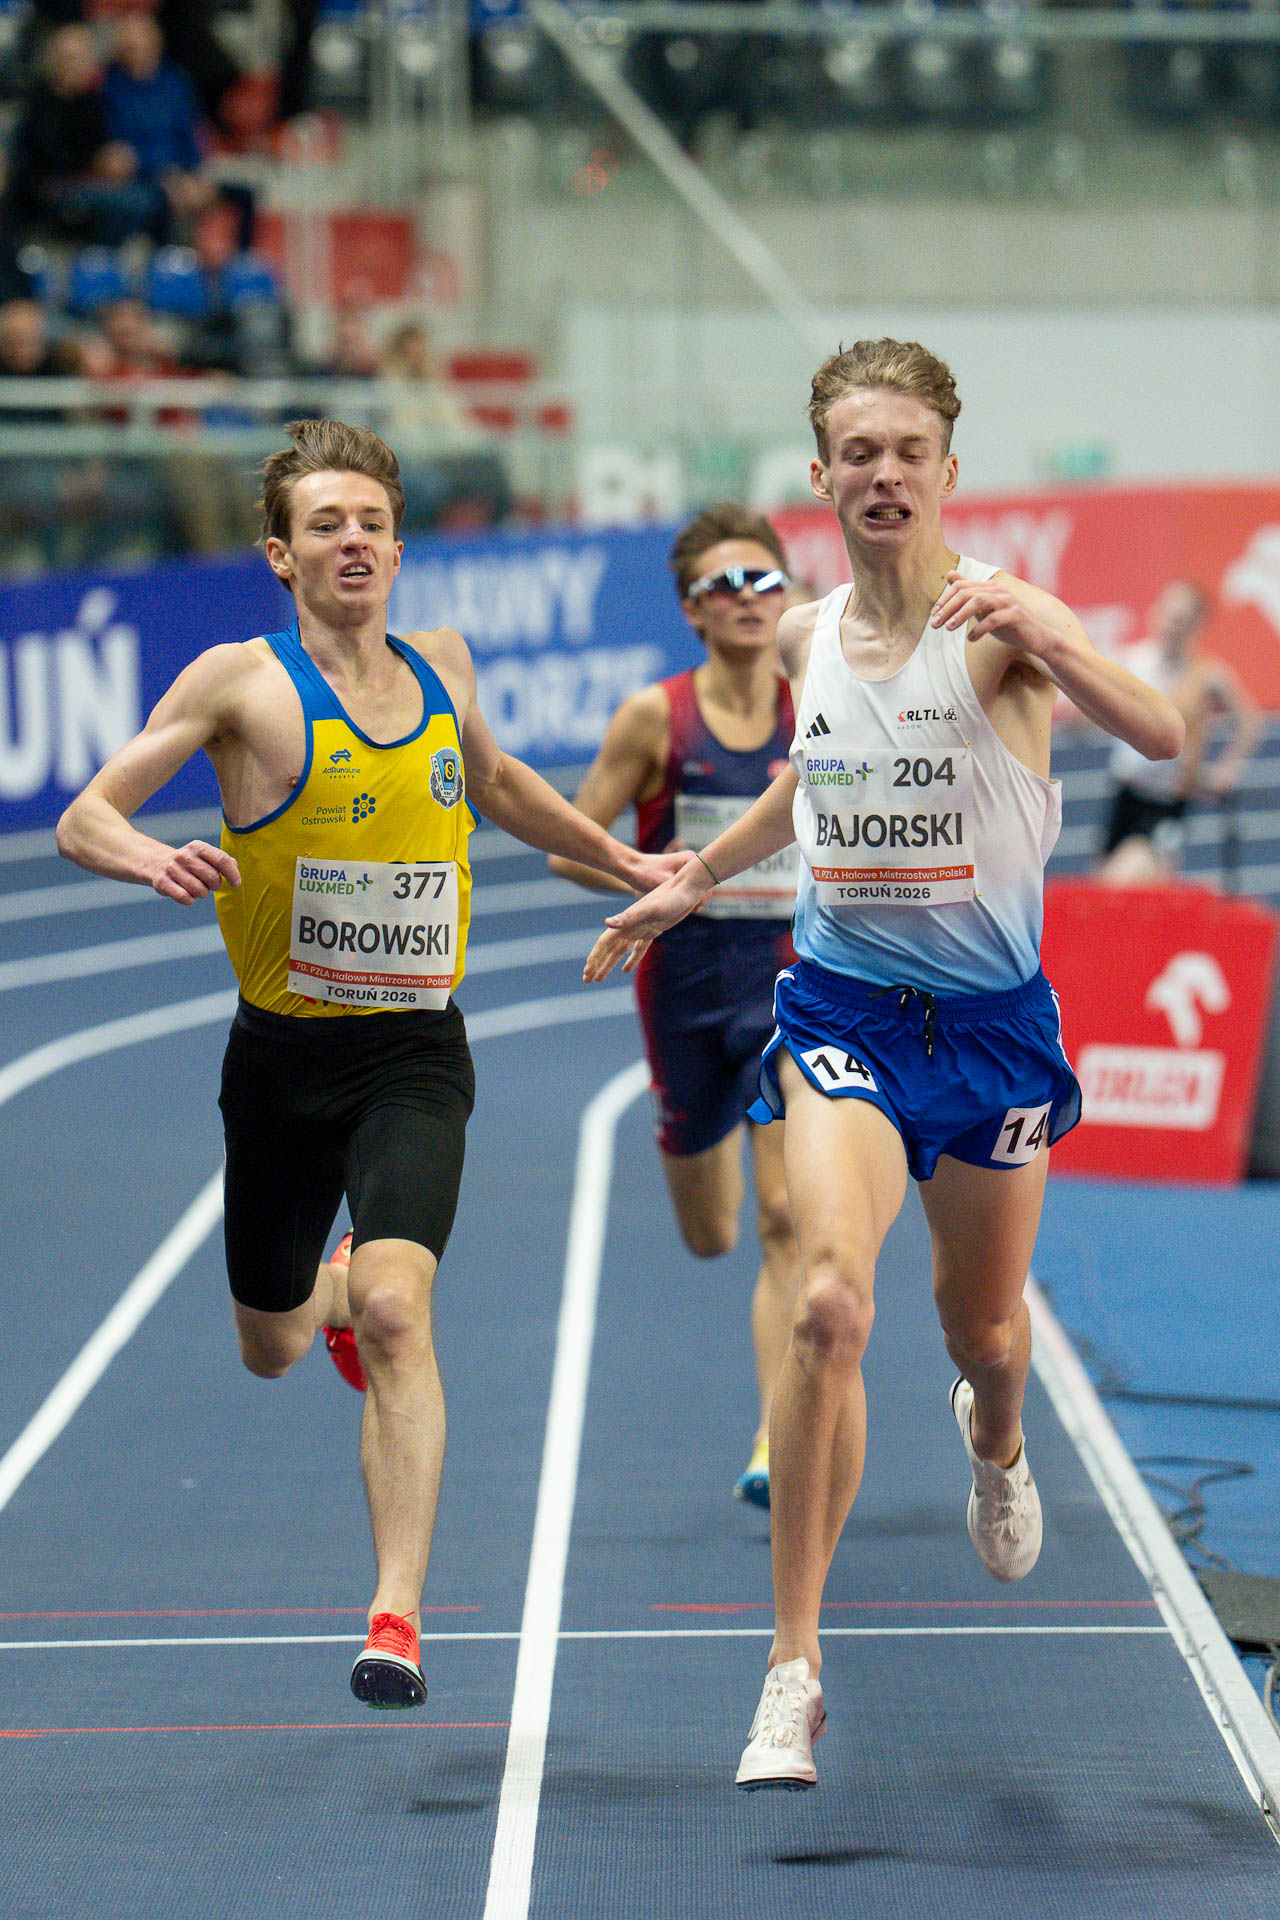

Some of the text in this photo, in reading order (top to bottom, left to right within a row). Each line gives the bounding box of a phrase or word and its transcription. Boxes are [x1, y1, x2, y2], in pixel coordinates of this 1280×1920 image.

[907, 709, 940, 721] RLTL
[446, 764, 454, 778] S
[806, 759, 846, 772] GRUPA
[893, 757, 956, 787] 204
[807, 773, 854, 786] LUXMED
[316, 806, 346, 816] Powiat
[301, 815, 346, 825] Ostrowski
[816, 812, 963, 848] BAJORSKI
[300, 866, 347, 882] GRUPA
[821, 870, 840, 879] PZLA
[841, 871, 878, 880] Halowe
[880, 870, 937, 880] Mistrzostwa
[939, 867, 967, 879] Polski
[299, 879, 355, 895] LUXMED
[392, 871, 448, 900] 377
[837, 883, 931, 899] TORUŃ 2026
[298, 915, 450, 956] BOROWSKI
[295, 962, 451, 986] 70. PZLA Halowe Mistrzostwa Polski
[326, 985, 417, 1003] TORUŃ 2026
[811, 1053, 870, 1081] 14
[1004, 1112, 1048, 1154] 14
